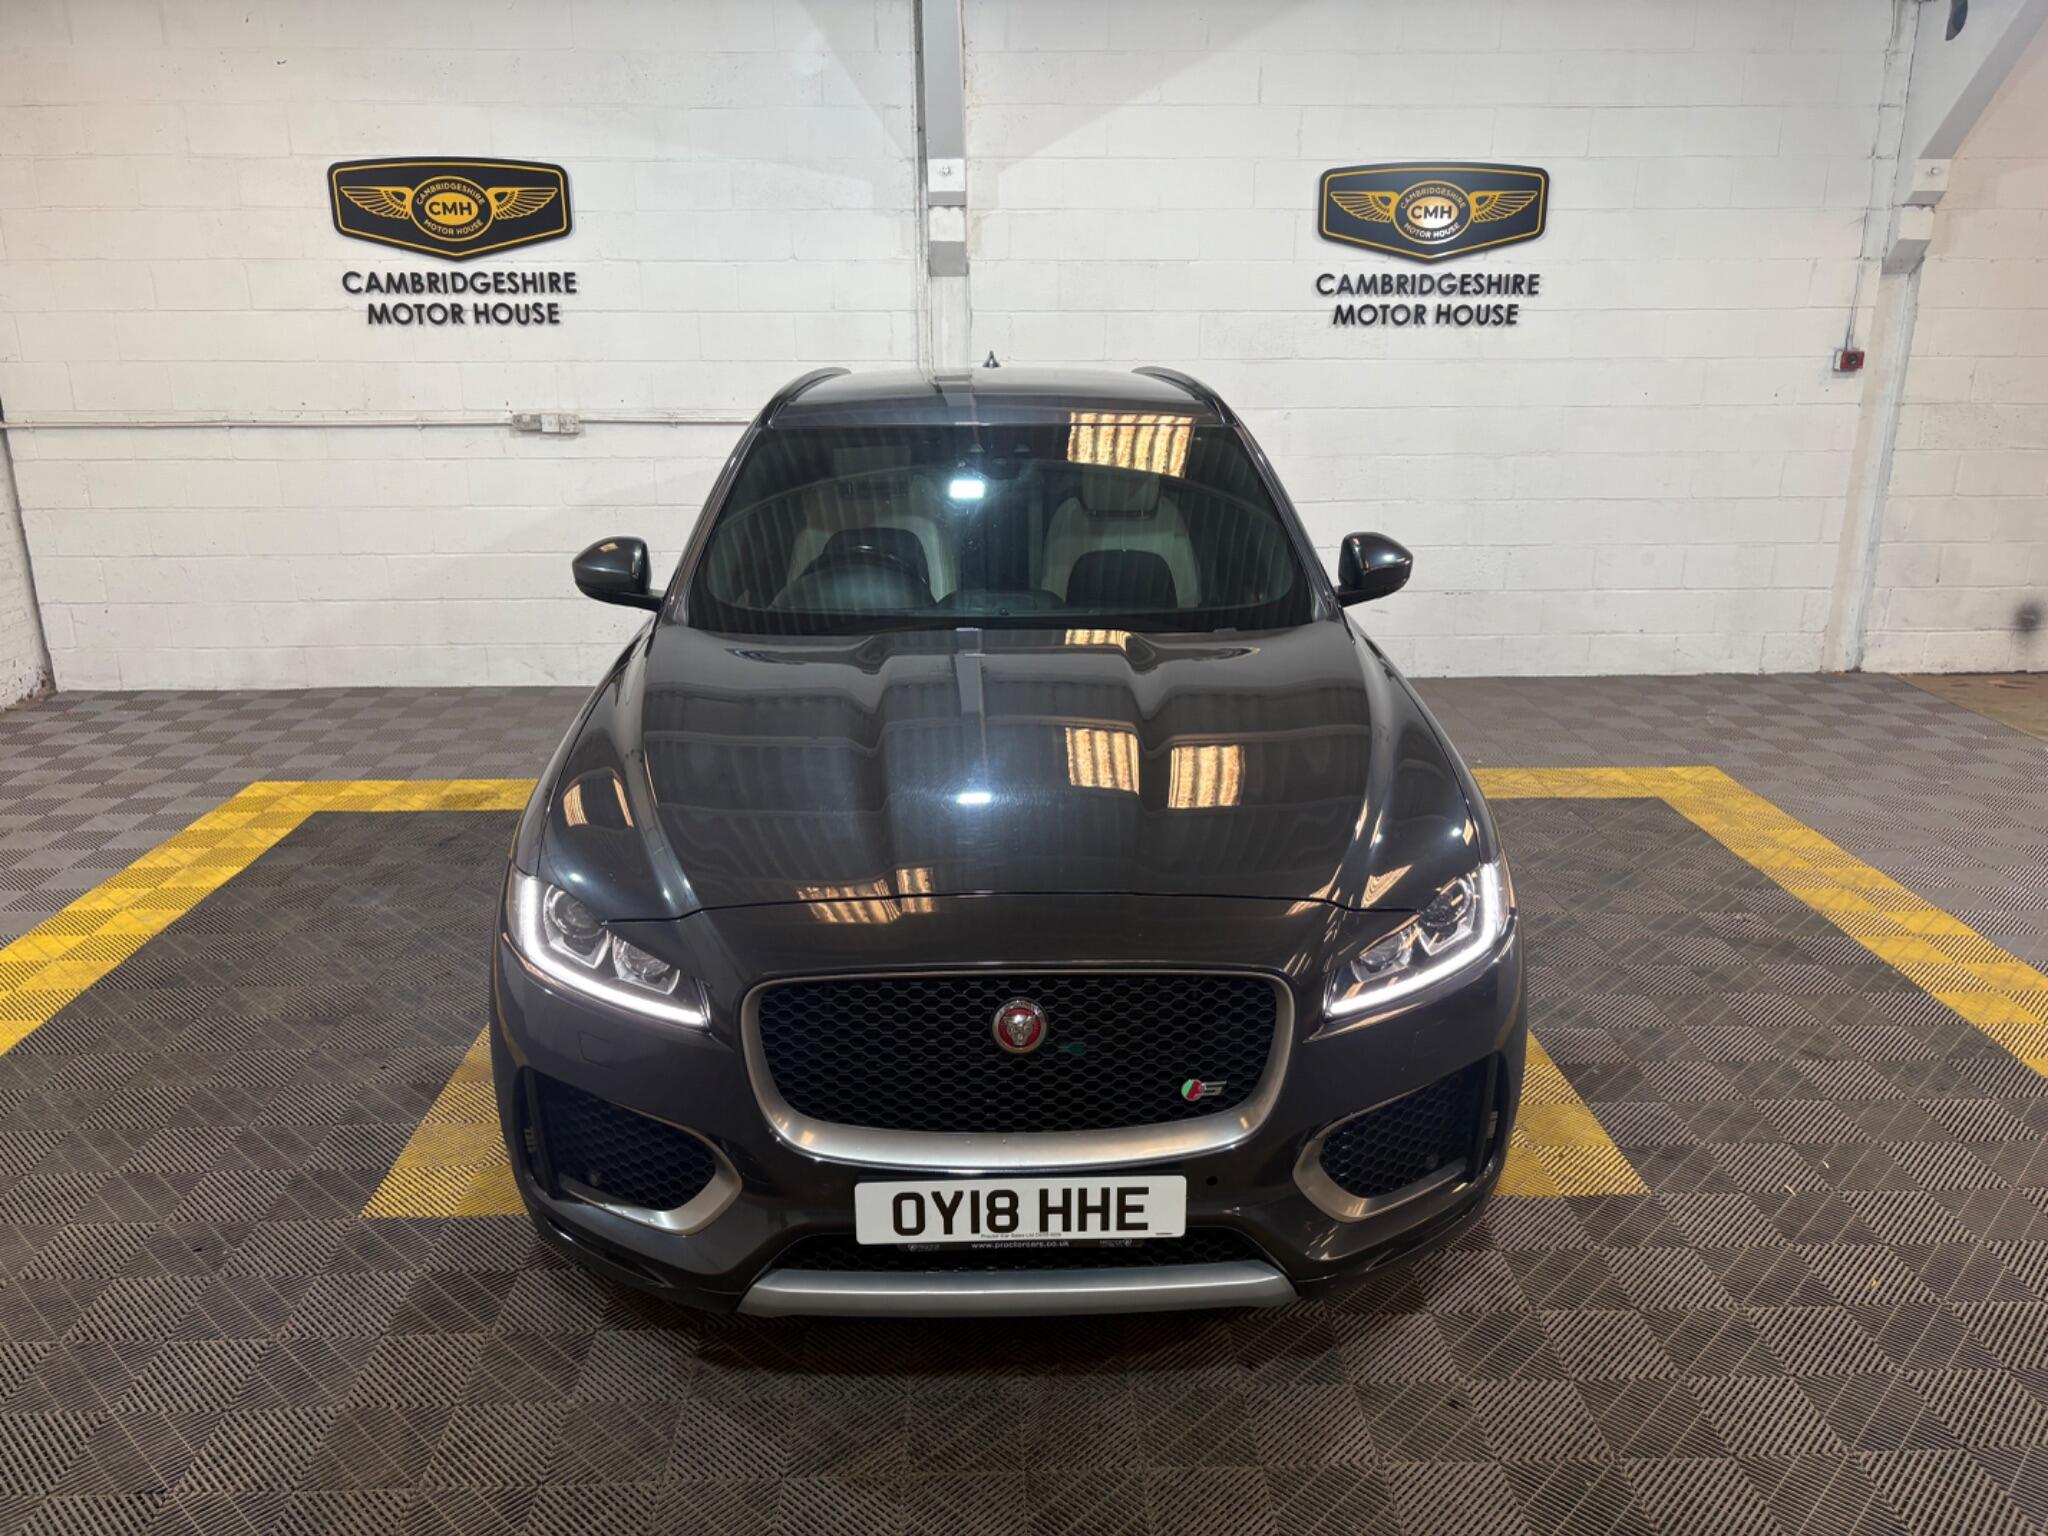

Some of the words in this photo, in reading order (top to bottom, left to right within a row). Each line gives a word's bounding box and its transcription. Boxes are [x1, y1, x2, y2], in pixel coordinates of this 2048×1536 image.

[416, 182, 486, 206] CAMBRIDGESHIRE
[1400, 187, 1467, 209] CAMBRIDGESHIRE
[428, 201, 473, 216] CMH
[1410, 204, 1453, 220] CMH
[422, 218, 455, 236] MOTOR
[456, 220, 484, 236] HOUSE
[1403, 222, 1432, 239] MOTOR
[1433, 222, 1461, 239] HOUSE
[342, 271, 578, 295] CAMBRIDGESHIRE
[1316, 272, 1541, 296] CAMBRIDGESHIRE
[368, 302, 465, 325] MOTOR
[474, 302, 560, 325] HOUSE
[1333, 304, 1427, 326] MOTOR
[1435, 303, 1520, 326] HOUSE
[892, 1188, 1020, 1237] OY18
[1038, 1186, 1150, 1233] HHE
